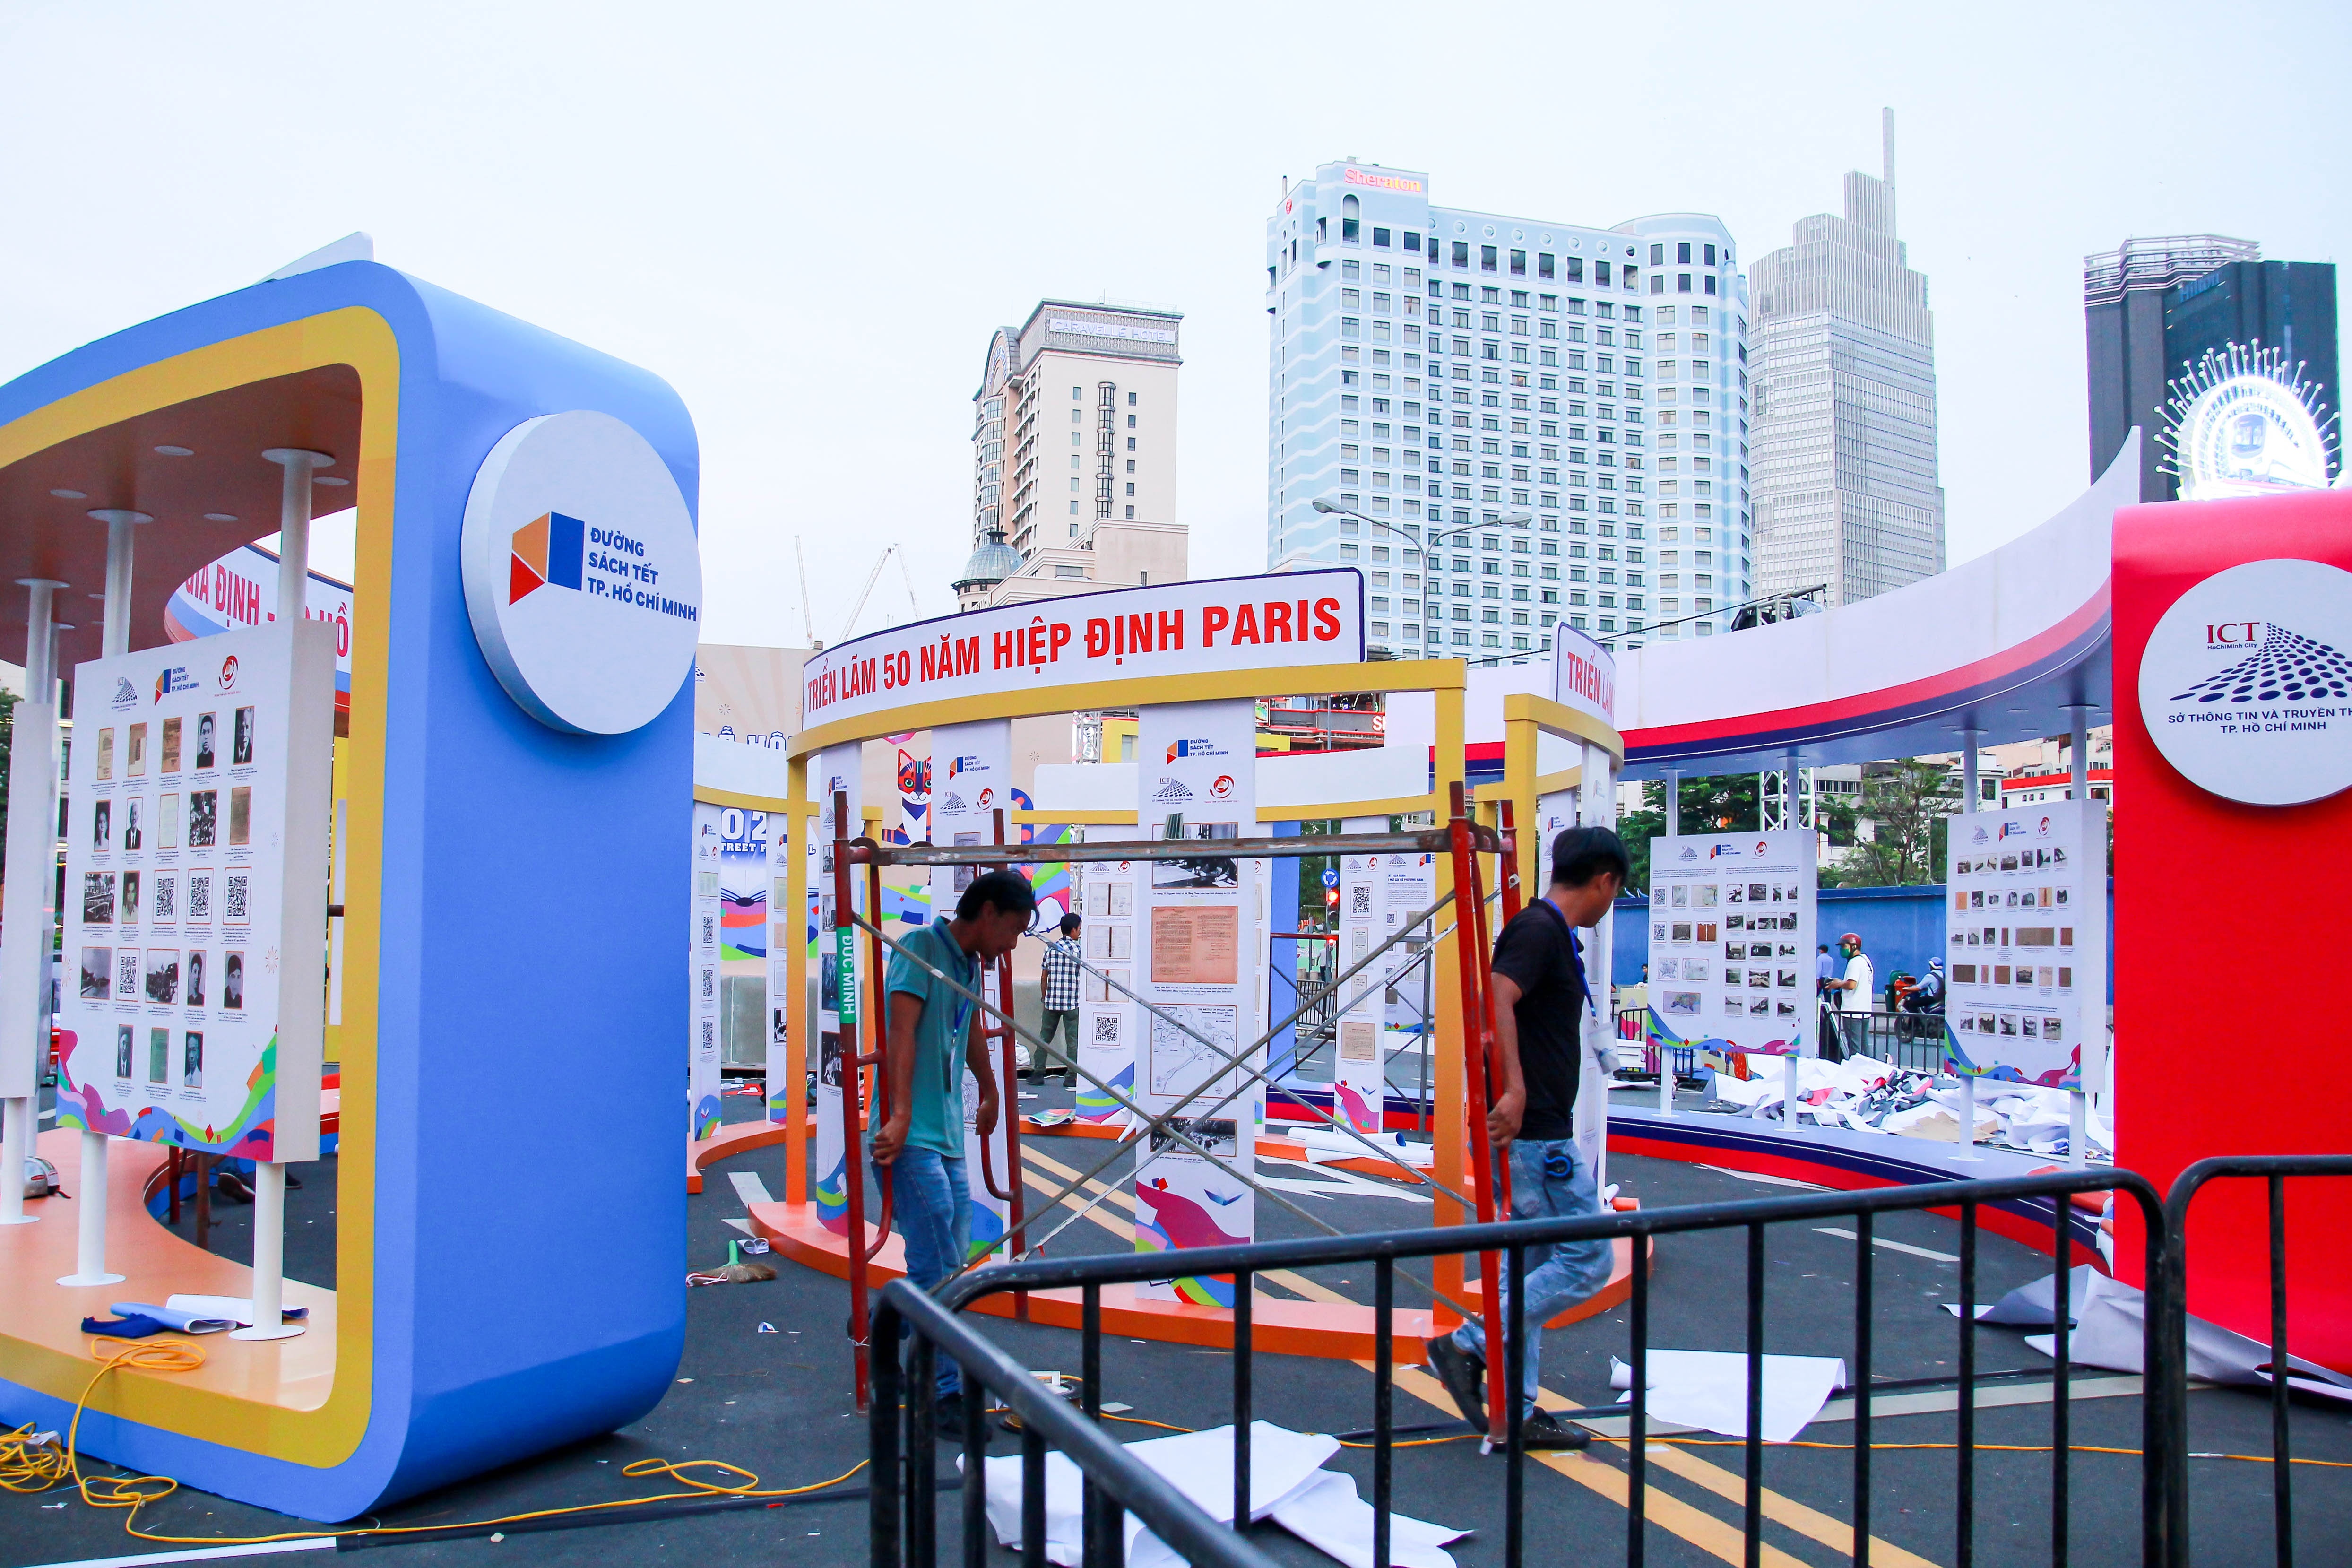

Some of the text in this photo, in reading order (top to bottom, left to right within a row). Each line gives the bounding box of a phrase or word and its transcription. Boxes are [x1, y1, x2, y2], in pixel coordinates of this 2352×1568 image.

[1344, 168, 1422, 193] Sheraton
[1054, 321, 1172, 342] CARAVELLE HOTEL
[590, 527, 644, 556] ĐƯỜNG
[588, 550, 658, 585] SÁCH TẾT
[215, 563, 259, 627] ĐỊNH
[588, 577, 697, 622] TP. HỒ CHÍ MINH
[2206, 622, 2260, 643] ICT
[807, 597, 1341, 713] TRIỂN LÃM 50 NĂM HIỆP ĐỊNH PARIS
[1567, 649, 1600, 704] TRIỂN
[2168, 713, 2185, 723] SỞ
[2188, 712, 2232, 722] THÔNG
[2236, 711, 2257, 720] TIN
[2262, 709, 2279, 719] VÀ
[2283, 707, 2335, 718] TRUYỀN
[2221, 721, 2326, 733] TP. HỒ CHÍ MINH
[843, 972, 855, 1014] MINH
